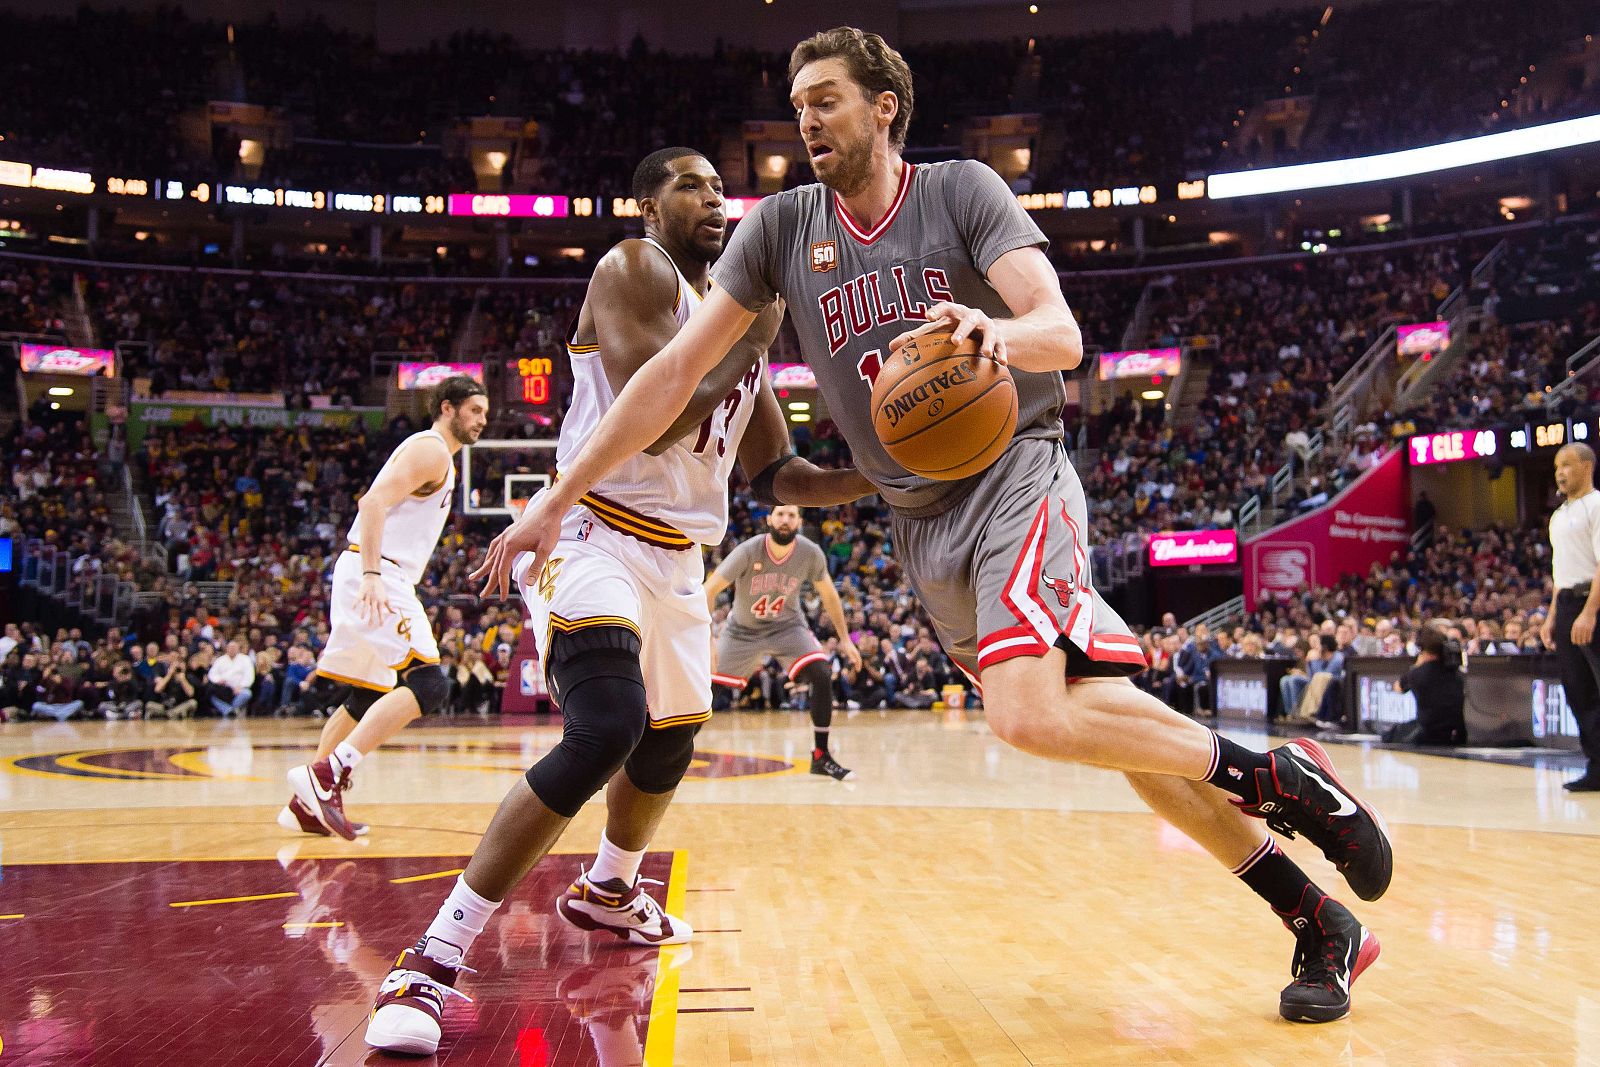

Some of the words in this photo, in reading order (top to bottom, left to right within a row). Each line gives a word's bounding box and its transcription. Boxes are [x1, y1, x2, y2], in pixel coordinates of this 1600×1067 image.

[817, 265, 954, 358] BULLS
[883, 360, 977, 429] SPALDING
[1432, 432, 1465, 461] CLE
[1151, 538, 1234, 561] Budweiser
[750, 572, 799, 596] BULLS
[751, 594, 786, 620] 44
